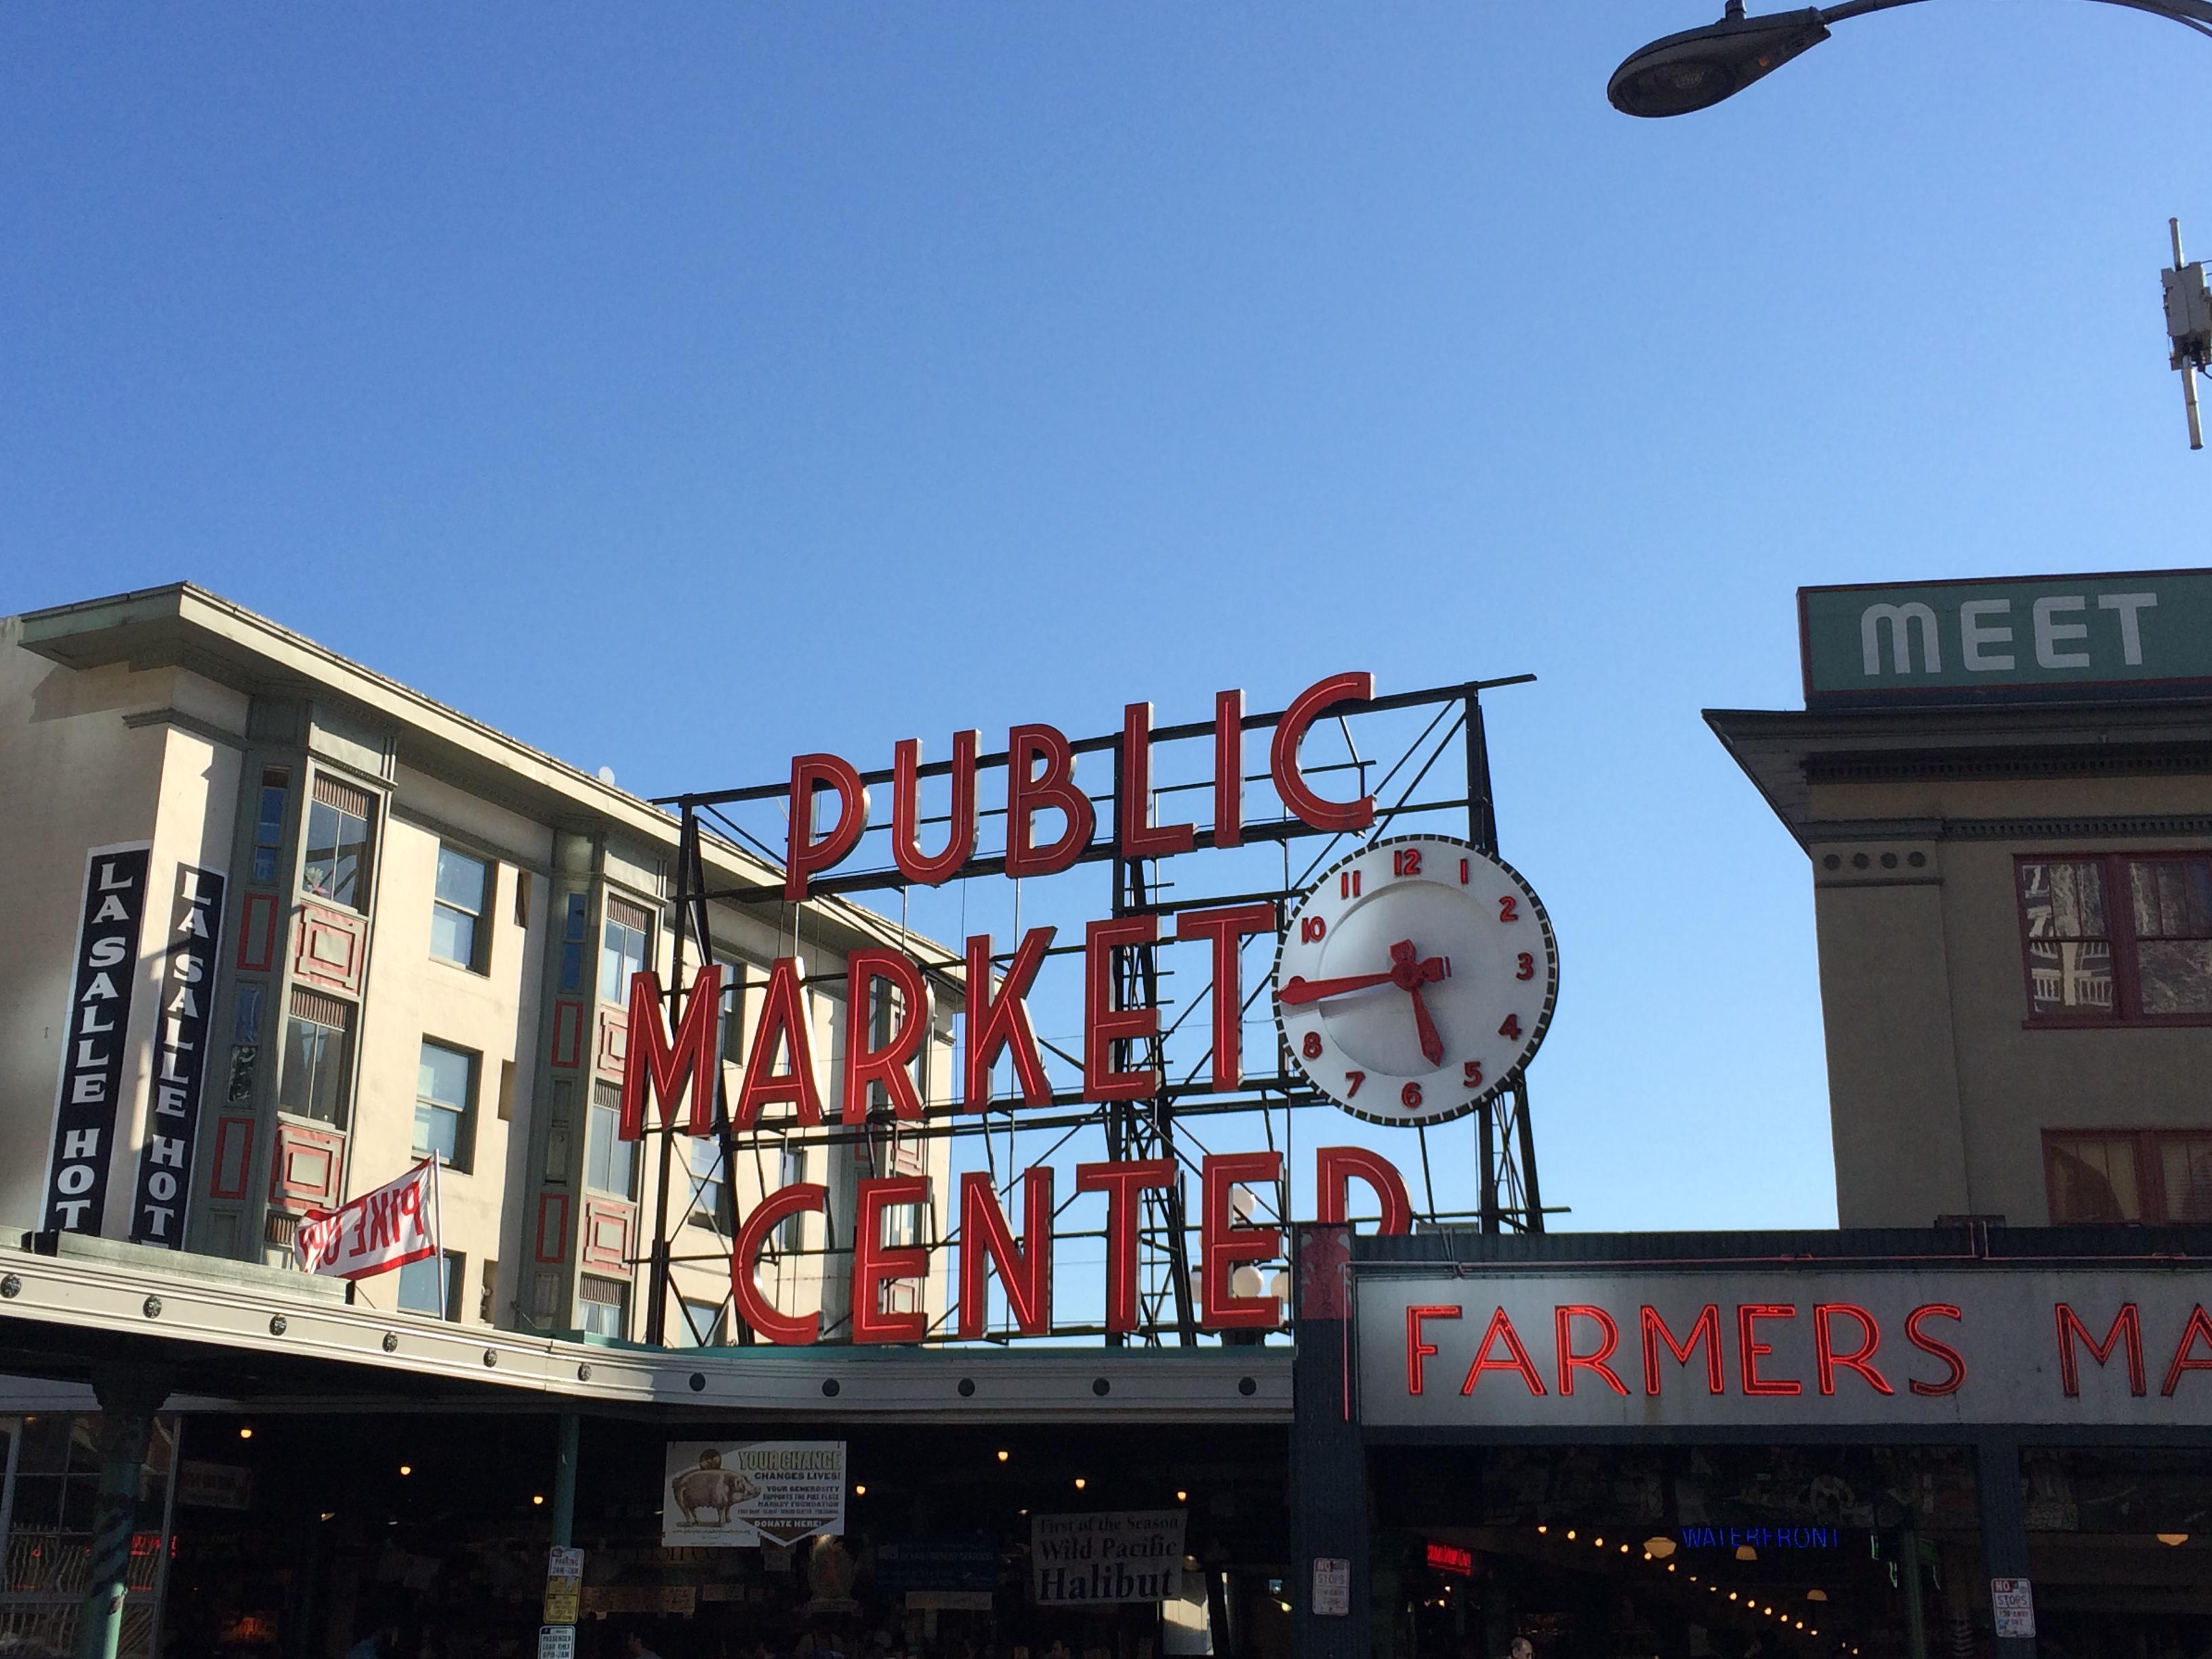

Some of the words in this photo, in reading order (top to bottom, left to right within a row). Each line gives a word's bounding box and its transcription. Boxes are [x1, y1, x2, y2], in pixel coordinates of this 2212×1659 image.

[1860, 592, 2158, 676] MEET
[784, 671, 1377, 902] PUBLIC
[1393, 848, 1420, 876] 12
[1460, 859, 1469, 884] 1
[91, 863, 133, 924] LA
[1340, 870, 1361, 899] 11
[177, 869, 212, 939] LA
[1498, 895, 1518, 922] 2
[1301, 916, 1326, 944] 10
[1515, 952, 1534, 981] 3
[70, 936, 127, 1104] SALLE
[617, 902, 1277, 1141] MARKET
[1498, 1013, 1521, 1040] 4
[155, 954, 203, 1118] SALLE
[1303, 1031, 1323, 1060] 8
[1345, 1071, 1366, 1097] 7
[1463, 1061, 1482, 1087] 5
[1401, 1082, 1422, 1109] 6
[140, 1134, 186, 1248] HOT
[1406, 1303, 1966, 1397] FARMERS
[738, 1450, 779, 1471] YOUR
[780, 1450, 841, 1471] CHANGE
[754, 1472, 804, 1480] CHANGES
[807, 1472, 841, 1480] LIVES!
[1040, 1519, 1073, 1533] First
[1078, 1515, 1092, 1531] of
[1099, 1517, 1118, 1531] the
[1127, 1517, 1179, 1530] Season
[1040, 1536, 1092, 1559] Wild
[1102, 1534, 1177, 1558] Pacific
[1040, 1562, 1173, 1600] Halibut
[1995, 1580, 2011, 1592] NO
[1997, 1594, 2028, 1605] STOPS
